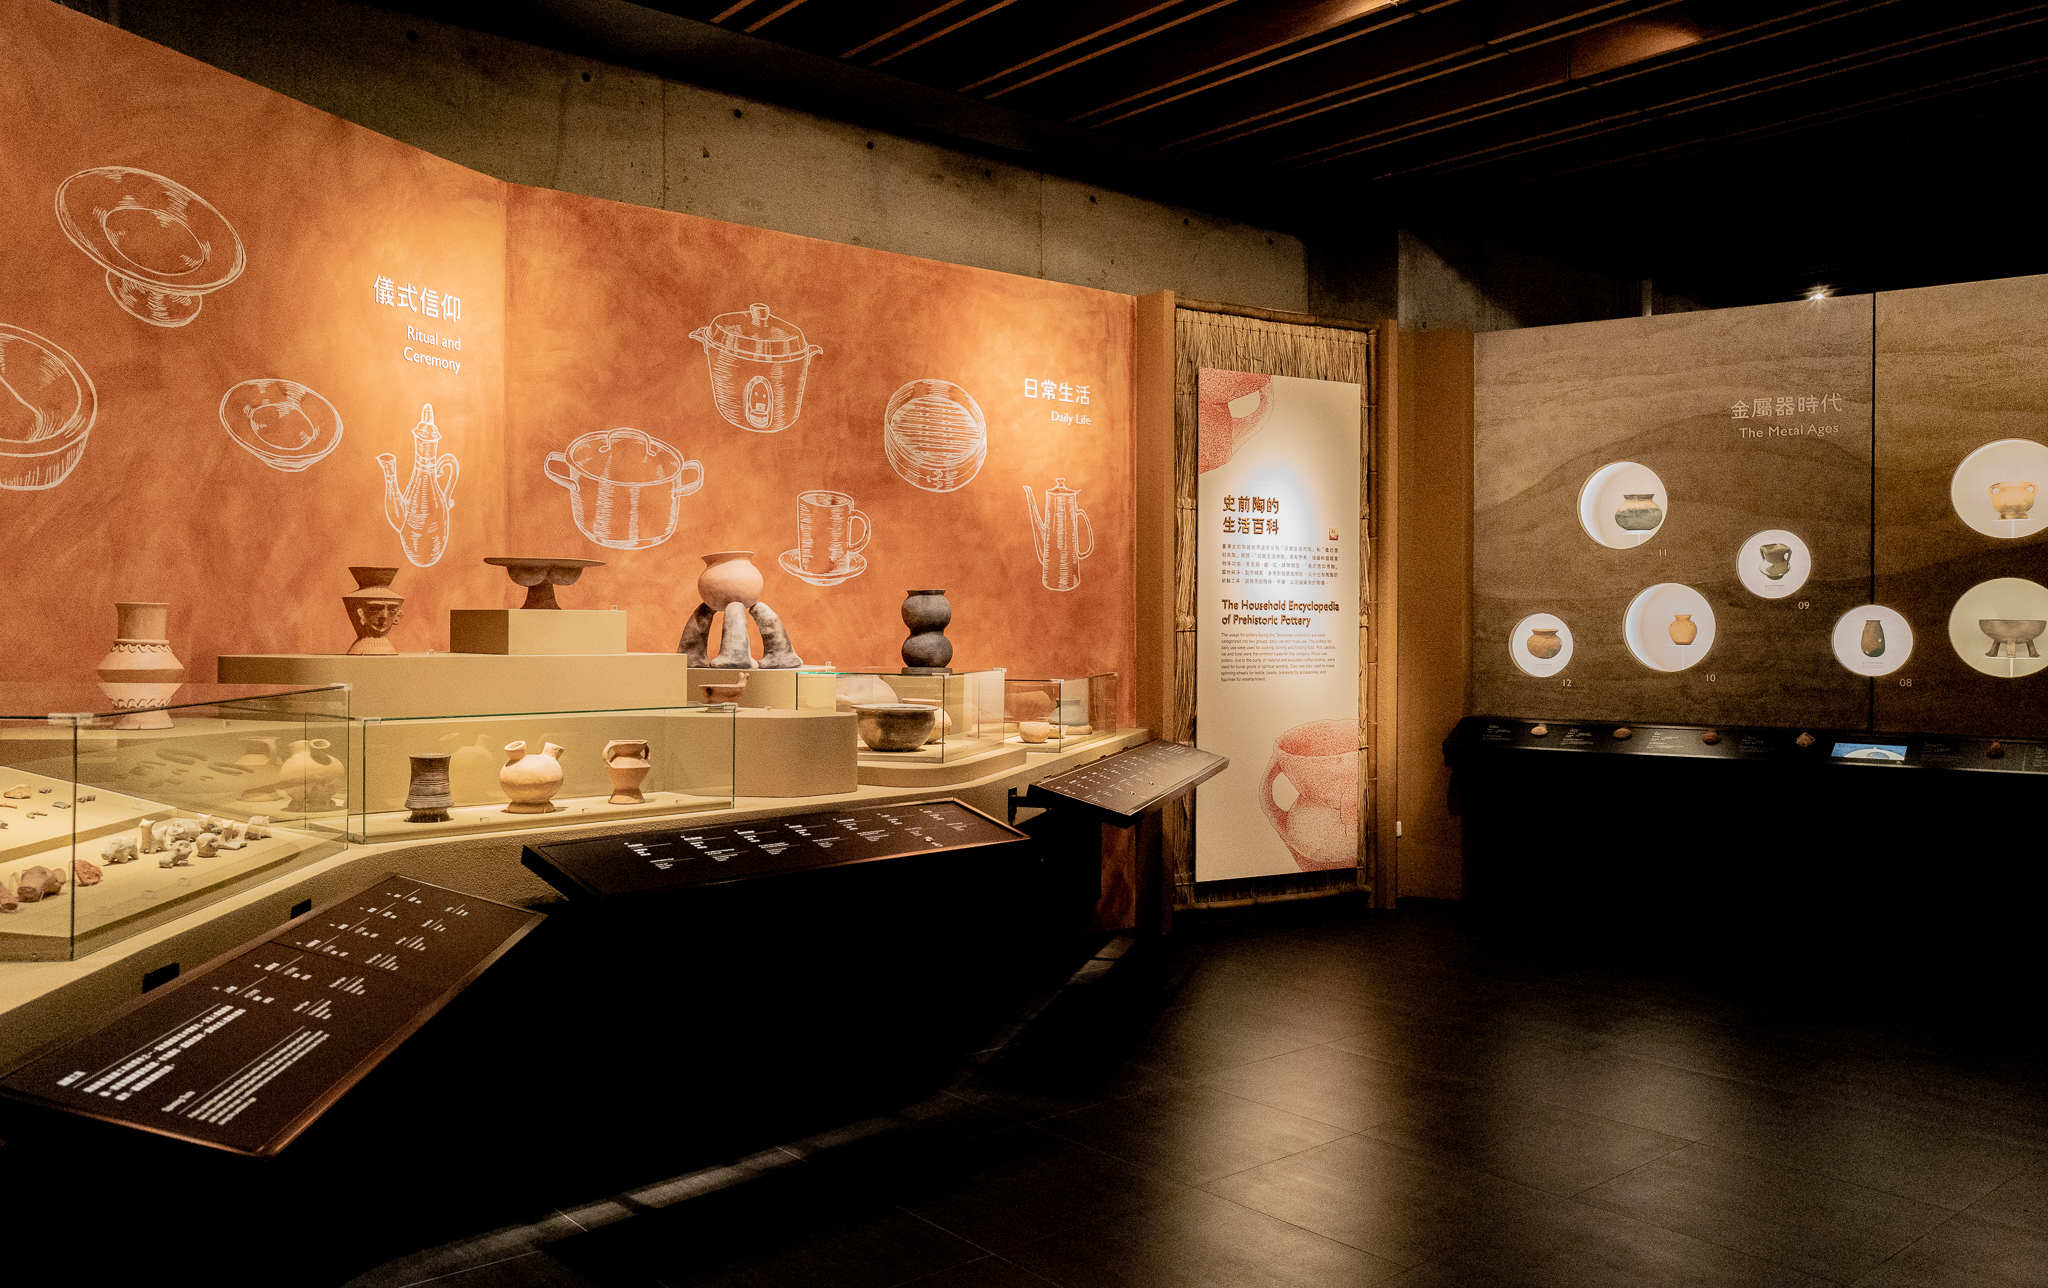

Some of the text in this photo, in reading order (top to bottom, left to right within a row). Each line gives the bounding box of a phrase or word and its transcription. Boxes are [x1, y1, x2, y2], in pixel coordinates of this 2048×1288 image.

[373, 274, 461, 323] 儀式信仰
[407, 325, 461, 351] Ritual and
[403, 346, 461, 375] Ceremony
[1024, 378, 1091, 405] 日常生活
[1730, 393, 1843, 419] 金屬器時代
[1051, 411, 1091, 426] Daily Life
[1739, 424, 1839, 438] The Metal Ages
[1222, 494, 1280, 515] 史前陶的
[1222, 516, 1280, 535] 生活百科
[1221, 599, 1340, 613] The Household Encyclopedia
[1798, 601, 1810, 610] 09
[1221, 614, 1312, 628] of Prehistoric Pottery
[1562, 679, 1572, 687] 12
[1706, 674, 1716, 682] 10
[1899, 678, 1912, 687] 08
